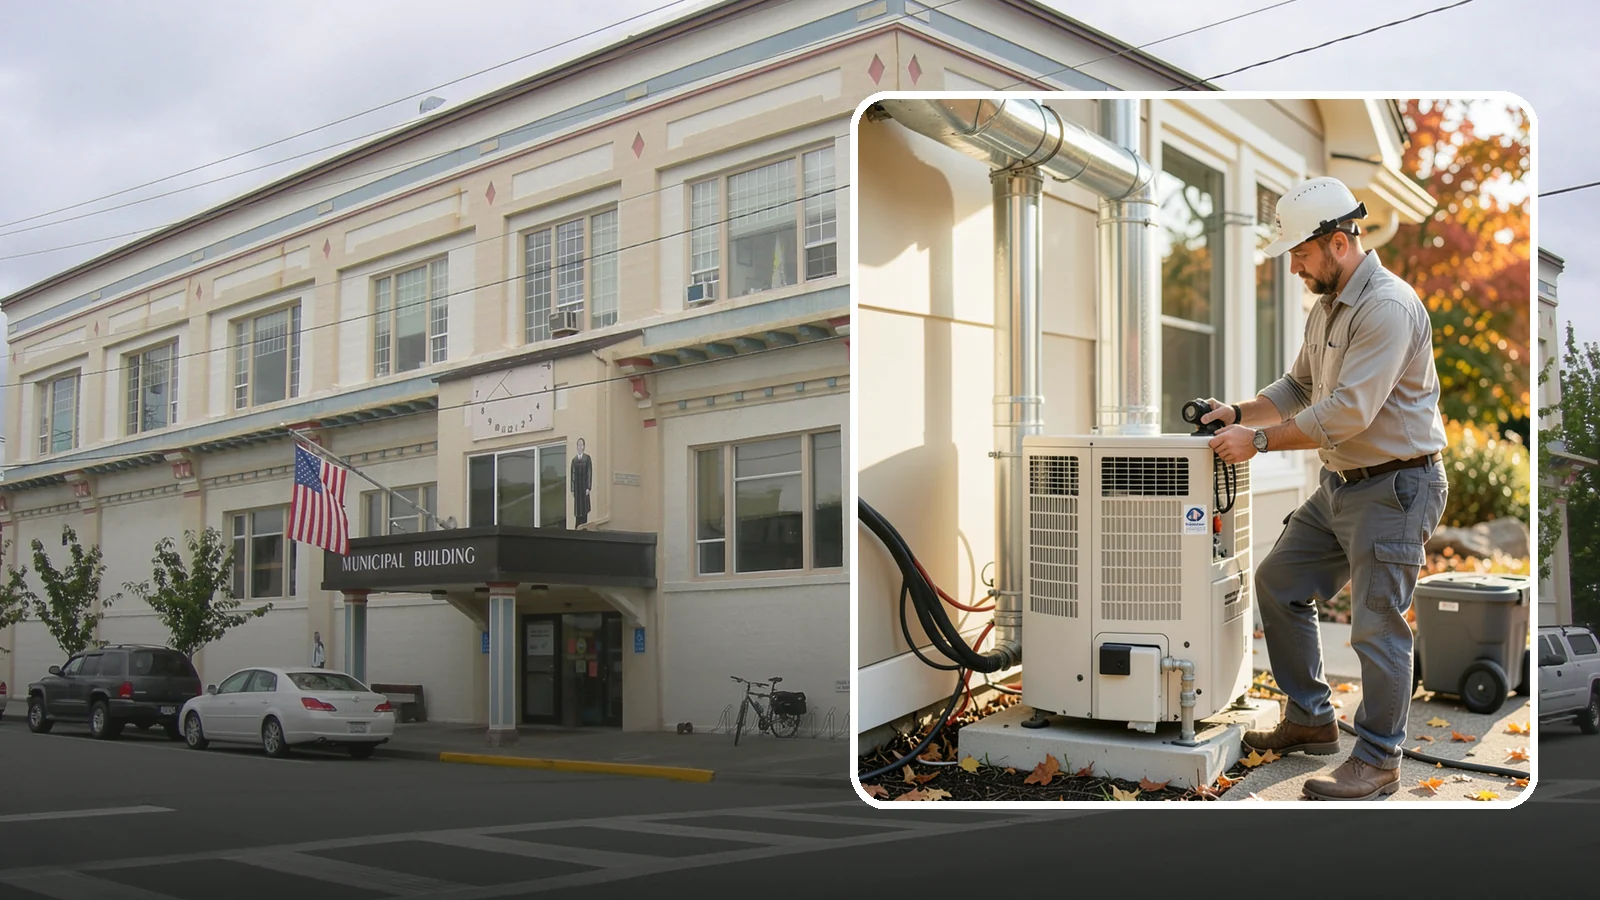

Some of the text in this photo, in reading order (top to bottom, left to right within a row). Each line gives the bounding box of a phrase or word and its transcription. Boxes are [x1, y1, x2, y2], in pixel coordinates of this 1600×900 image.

[475, 390, 479, 398] 7
[536, 402, 540, 410] 4
[480, 407, 485, 415] 8
[488, 417, 492, 426] 9
[529, 414, 533, 422] 3
[495, 423, 500, 431] 10
[521, 420, 526, 428] 2
[507, 425, 513, 433] 12
[342, 546, 475, 572] MUNICIPAL BUILDING
